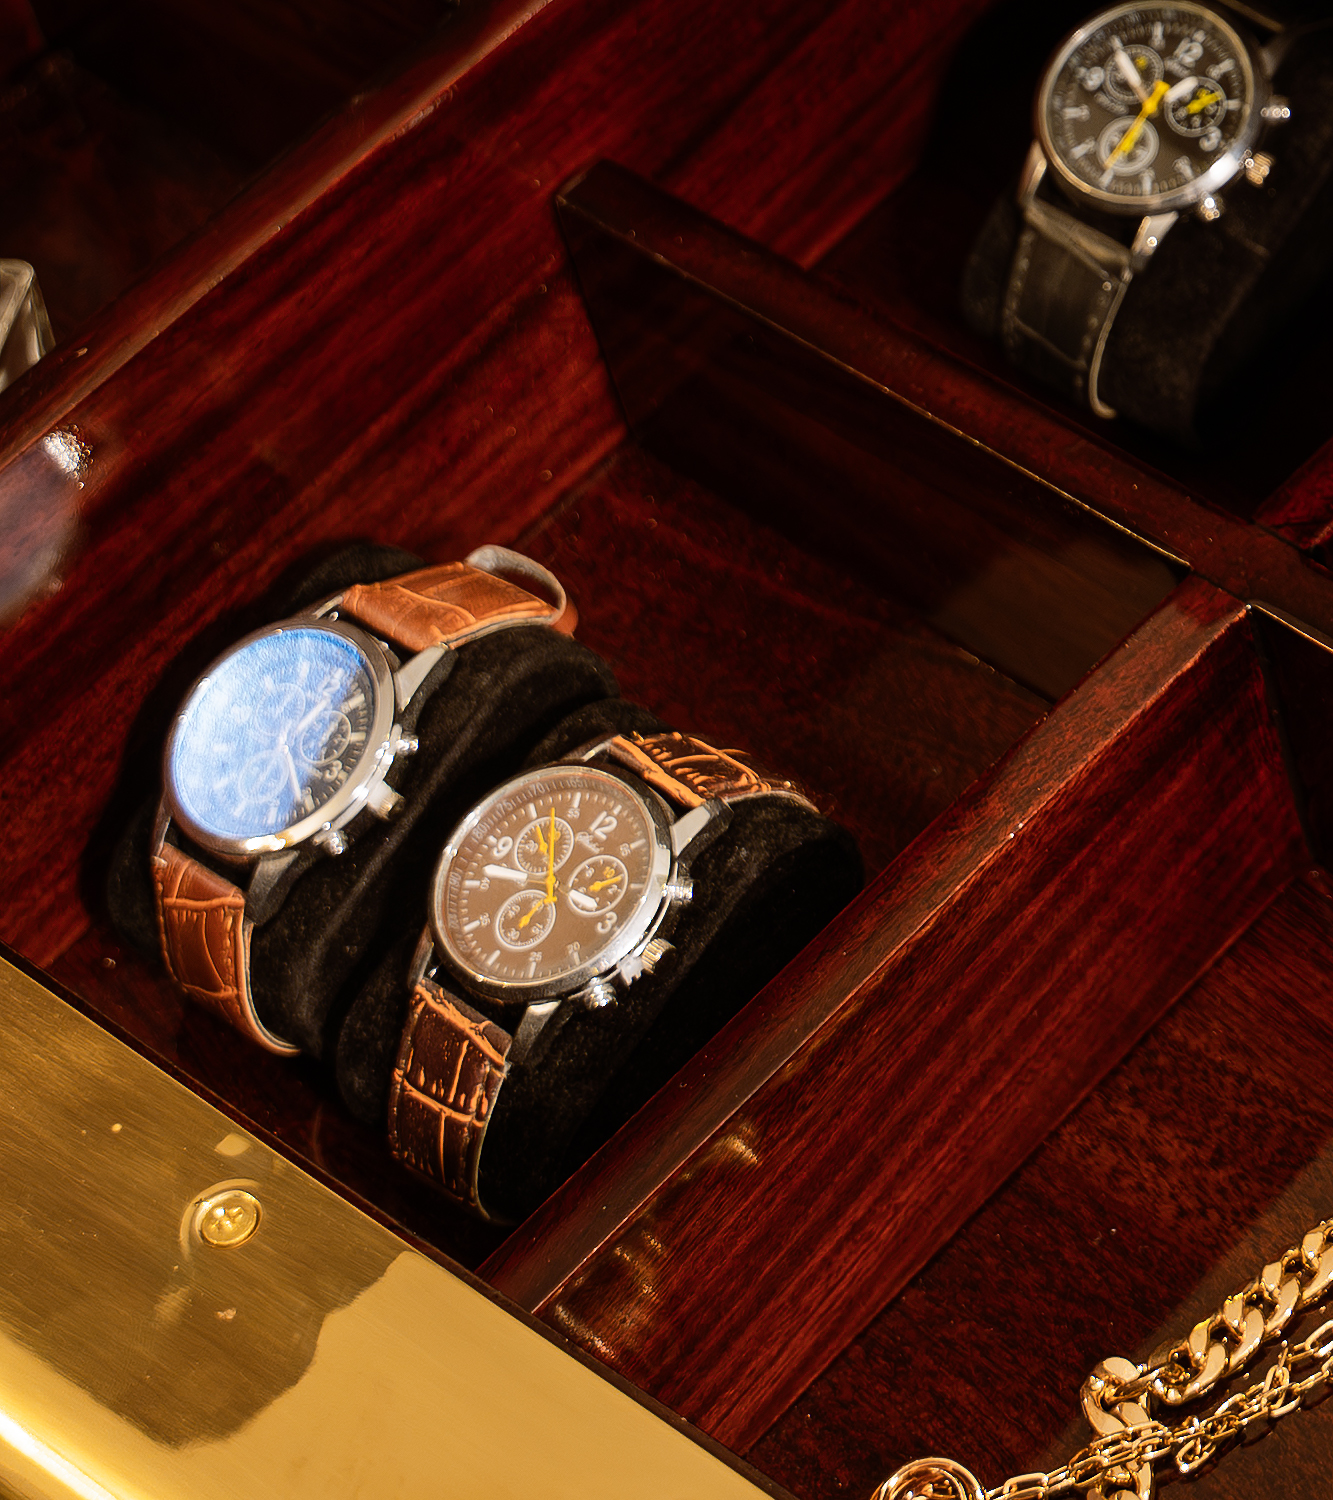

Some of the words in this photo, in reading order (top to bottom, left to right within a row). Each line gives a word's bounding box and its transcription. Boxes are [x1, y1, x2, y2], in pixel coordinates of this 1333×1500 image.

[589, 811, 618, 841] 12
[492, 835, 514, 861] 9
[597, 911, 618, 935] 3
